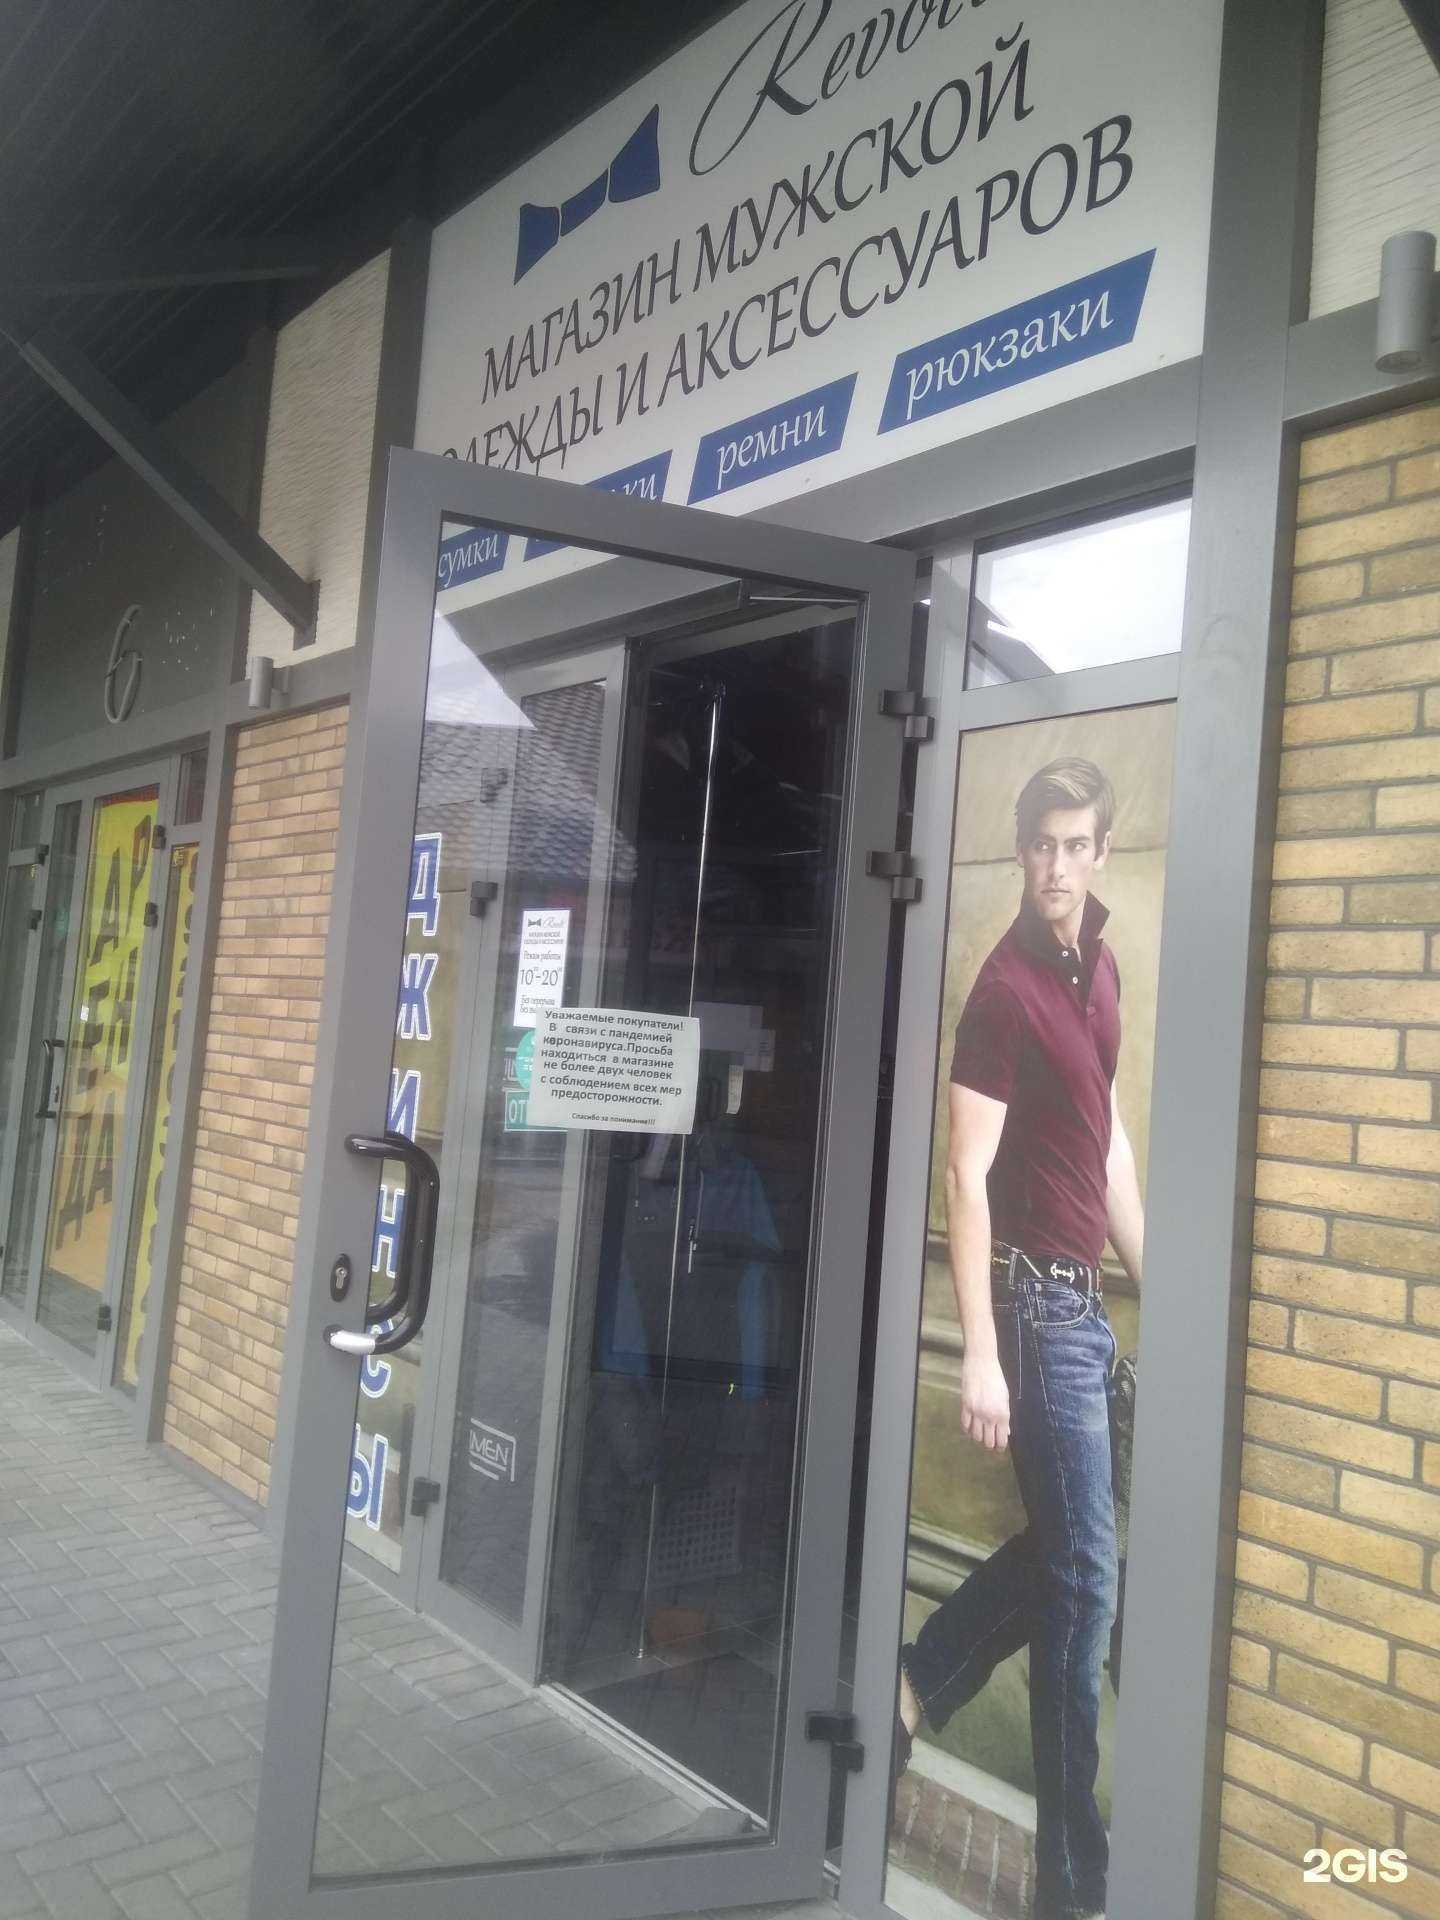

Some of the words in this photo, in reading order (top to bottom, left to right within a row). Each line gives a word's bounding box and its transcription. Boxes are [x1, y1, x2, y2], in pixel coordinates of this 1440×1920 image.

[689, 0, 986, 175] Revo
[482, 238, 682, 403] МАГАЗИН
[693, 21, 1035, 293] МУЖСКОЙ
[442, 376, 603, 477] ЕЖДЫ
[616, 361, 651, 426] И
[657, 115, 1134, 407] АКСЕССУАРОВ
[905, 290, 1113, 420] рюкзаки
[716, 401, 827, 486] ремни
[438, 534, 498, 588] сумки
[545, 1010, 614, 1025] Уважаемые
[617, 1016, 684, 1031] покупатели!
[549, 1023, 557, 1032] В
[565, 1024, 598, 1036] связи
[600, 1028, 606, 1036] с
[609, 1029, 673, 1043] пандемией
[541, 1049, 607, 1063] находиться
[621, 1056, 674, 1069] магазине
[543, 1061, 558, 1070] не
[560, 1060, 595, 1073] более
[597, 1066, 624, 1077] двух
[627, 1069, 672, 1080] человек
[540, 1075, 546, 1084] с
[549, 1075, 630, 1091] соблюдением
[633, 1083, 657, 1093] всех
[659, 1086, 682, 1097] мер
[551, 1088, 663, 1106] предосторожности.
[571, 1112, 599, 1121] Спасибо
[470, 1429, 509, 1466] MEN
